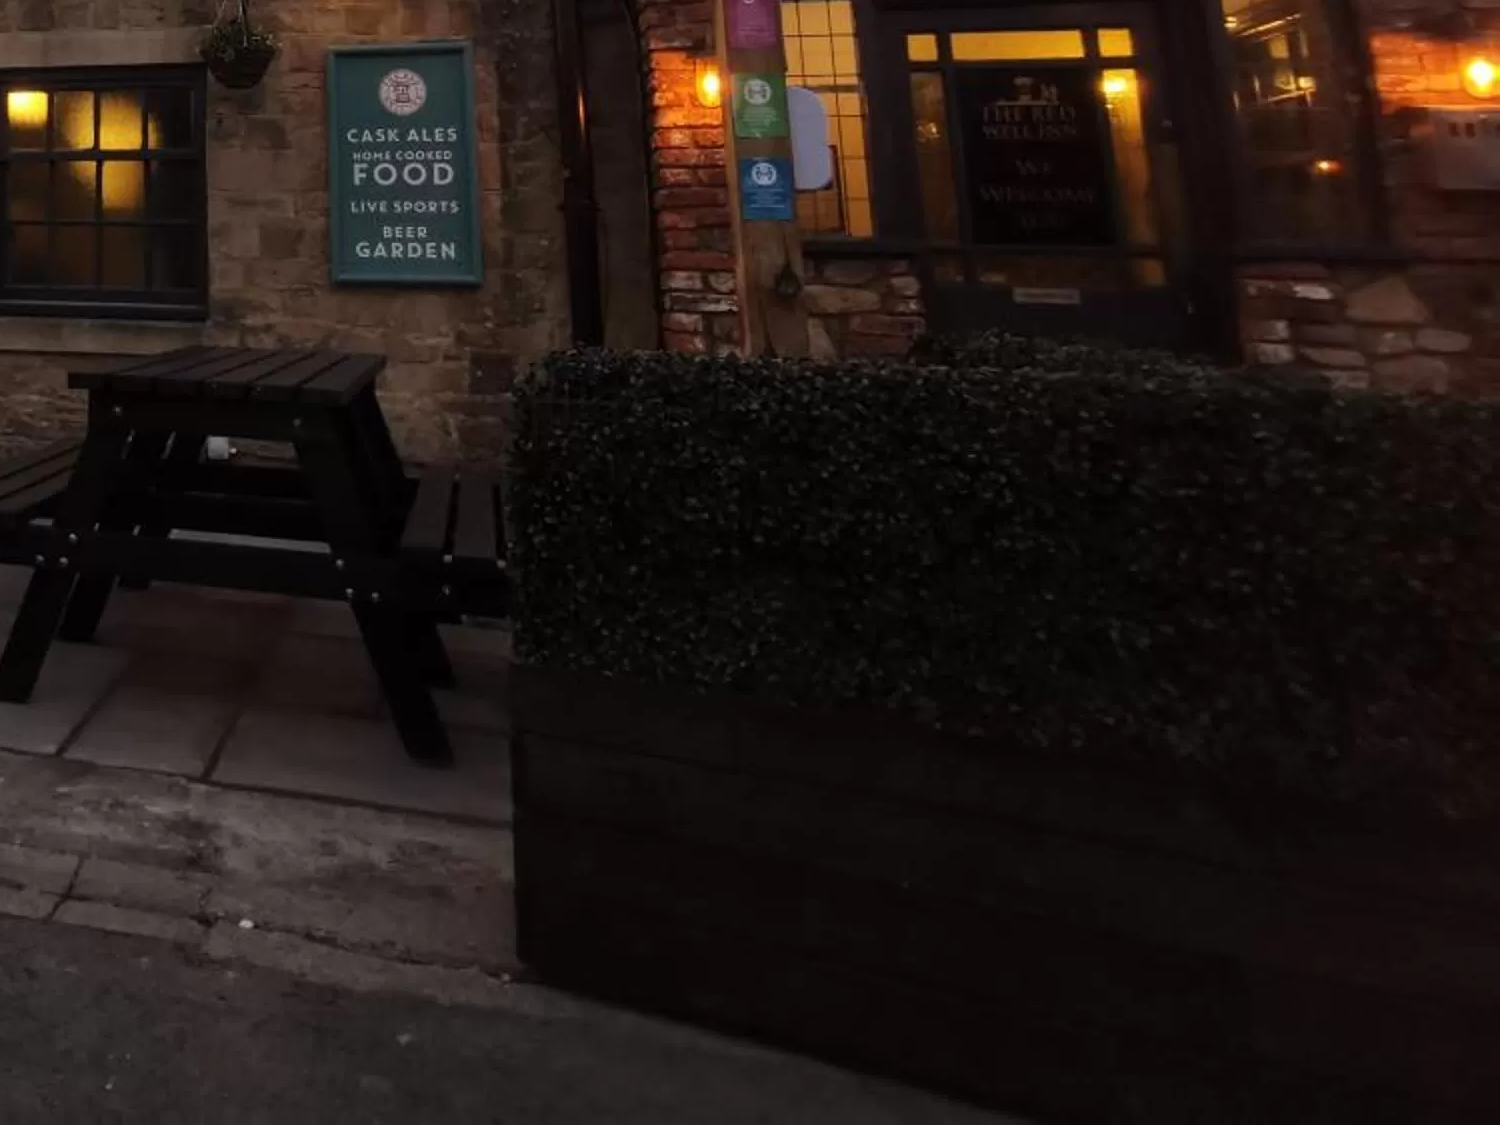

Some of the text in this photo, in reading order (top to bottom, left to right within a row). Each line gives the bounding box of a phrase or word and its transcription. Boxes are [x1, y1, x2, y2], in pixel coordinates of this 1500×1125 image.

[346, 127, 458, 143] CASK ALES
[352, 150, 453, 161] HOME COOKED
[352, 162, 455, 186] FOOD
[350, 200, 460, 215] LIVE SPORTS
[382, 225, 428, 238] BEER
[354, 241, 456, 260] GARDEN
